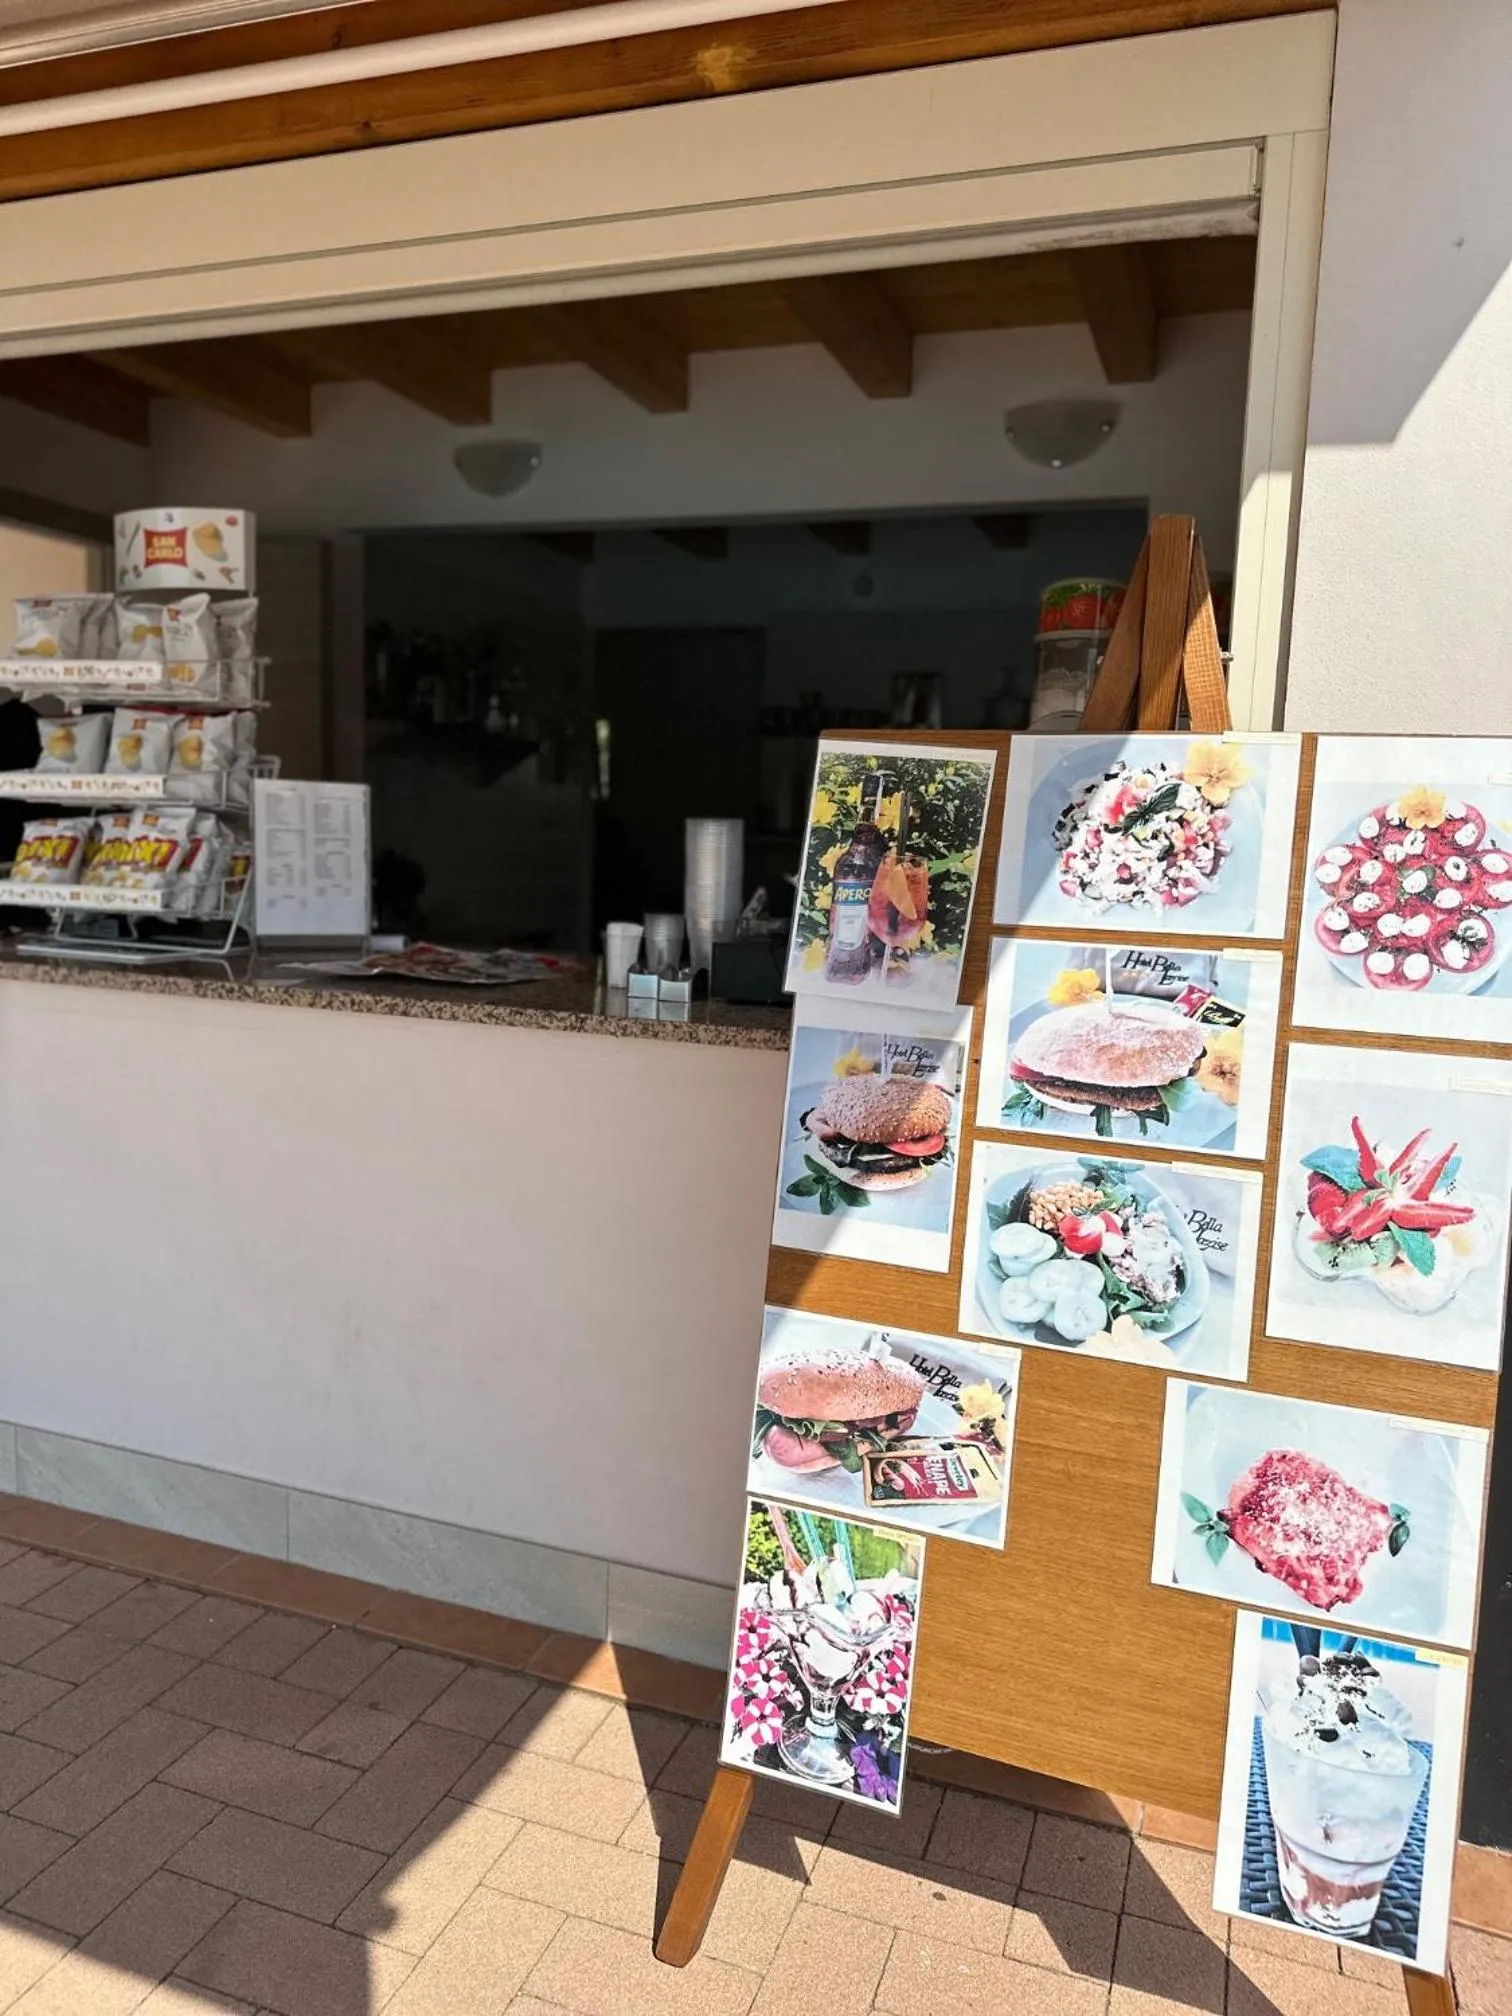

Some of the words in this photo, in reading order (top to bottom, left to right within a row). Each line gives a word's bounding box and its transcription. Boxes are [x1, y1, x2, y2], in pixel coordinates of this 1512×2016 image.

[152, 536, 177, 547] SAN
[147, 547, 184, 559] CARLO
[834, 886, 872, 900] APERO
[1187, 1209, 1223, 1233] Bella
[926, 1364, 962, 1389] Bella
[930, 1458, 952, 1496] ENAPE
